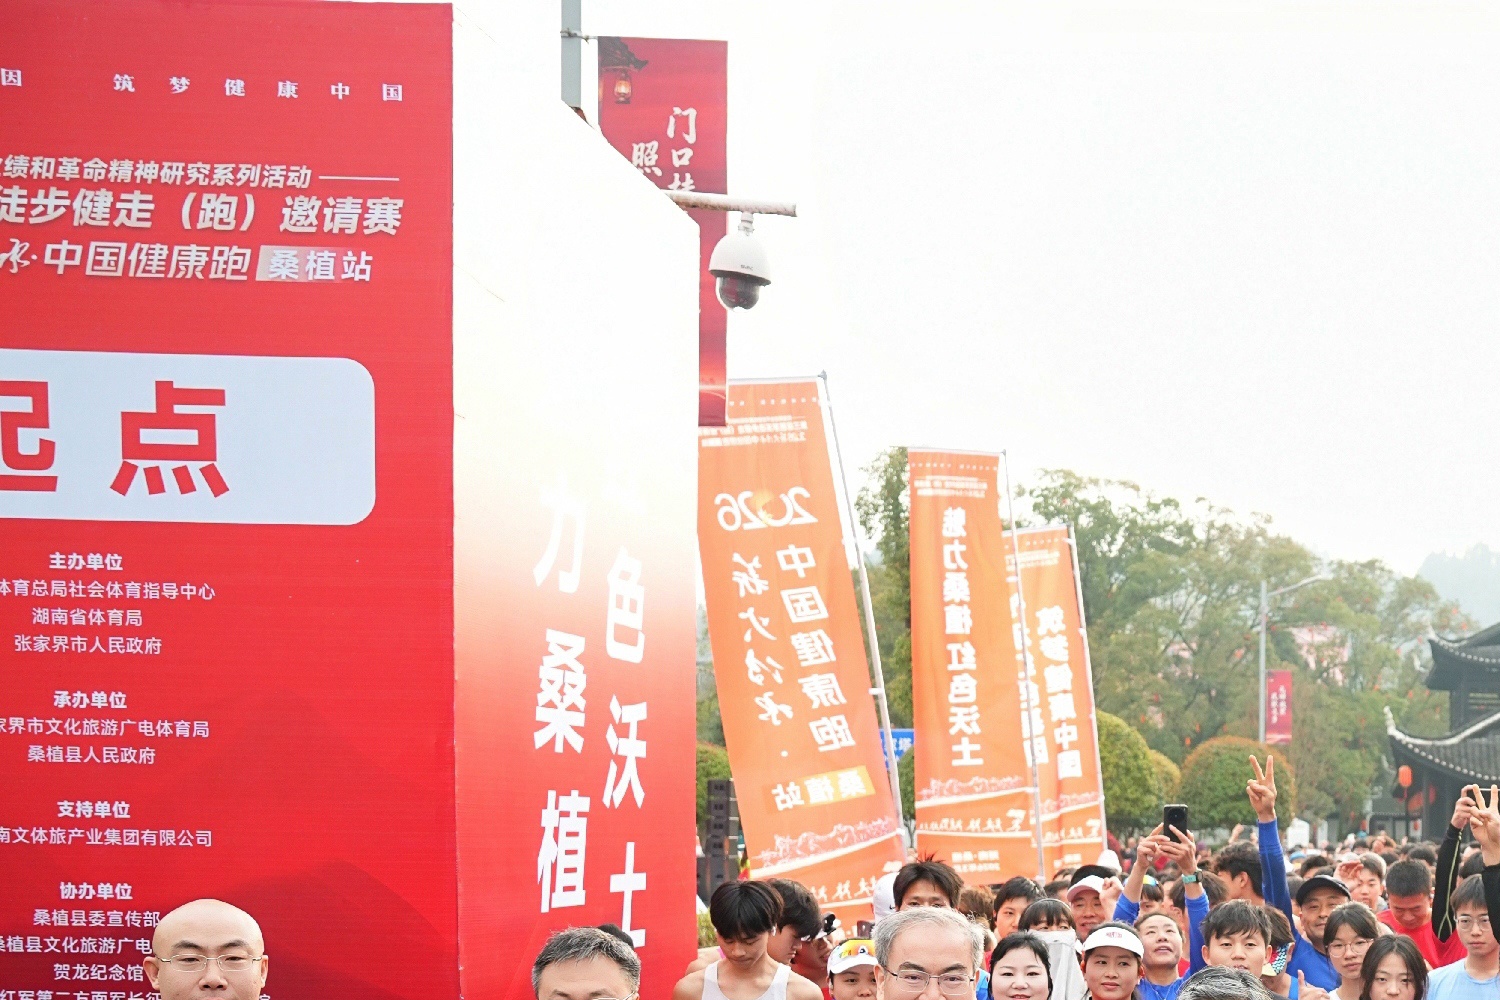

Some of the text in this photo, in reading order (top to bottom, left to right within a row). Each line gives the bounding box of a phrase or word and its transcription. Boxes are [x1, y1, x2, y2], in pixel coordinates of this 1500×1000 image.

[1, 68, 403, 102] 因 筑梦健康中国
[0, 155, 313, 189] 绩和革命精神研究系列活动
[268, 249, 374, 283] 桑植站
[48, 552, 124, 571] 主办单位
[31, 607, 143, 627] 湖南省体育局
[14, 634, 163, 655] 张家界市人民政府
[53, 690, 128, 710] 承办单位
[27, 745, 156, 765] 桑植县人民政府
[57, 800, 131, 819] 支持单位
[59, 881, 133, 901] 协办单位
[32, 909, 161, 928] 桑植县委宣传部
[53, 963, 145, 982] 贺龙纪念馆
